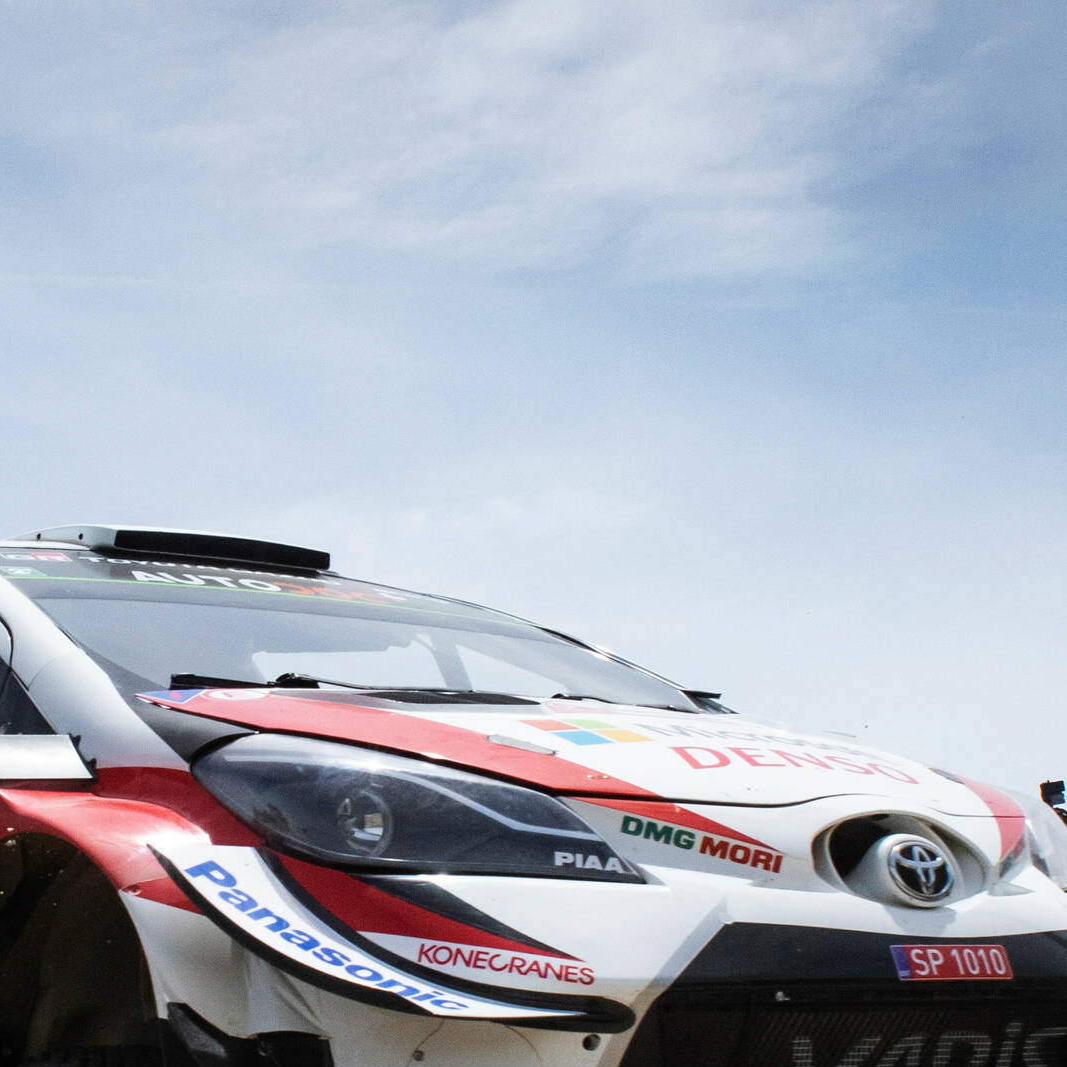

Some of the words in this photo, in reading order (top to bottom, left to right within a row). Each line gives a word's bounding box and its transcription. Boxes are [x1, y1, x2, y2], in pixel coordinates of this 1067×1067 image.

[669, 746, 920, 786] DENSO
[554, 851, 625, 874] PIAA
[621, 815, 696, 850] DMG
[698, 835, 783, 873] MORI
[184, 859, 470, 1012] Panasonic
[417, 943, 595, 985] KONECRANES
[910, 948, 944, 976] SP
[950, 948, 1006, 975] 1010
